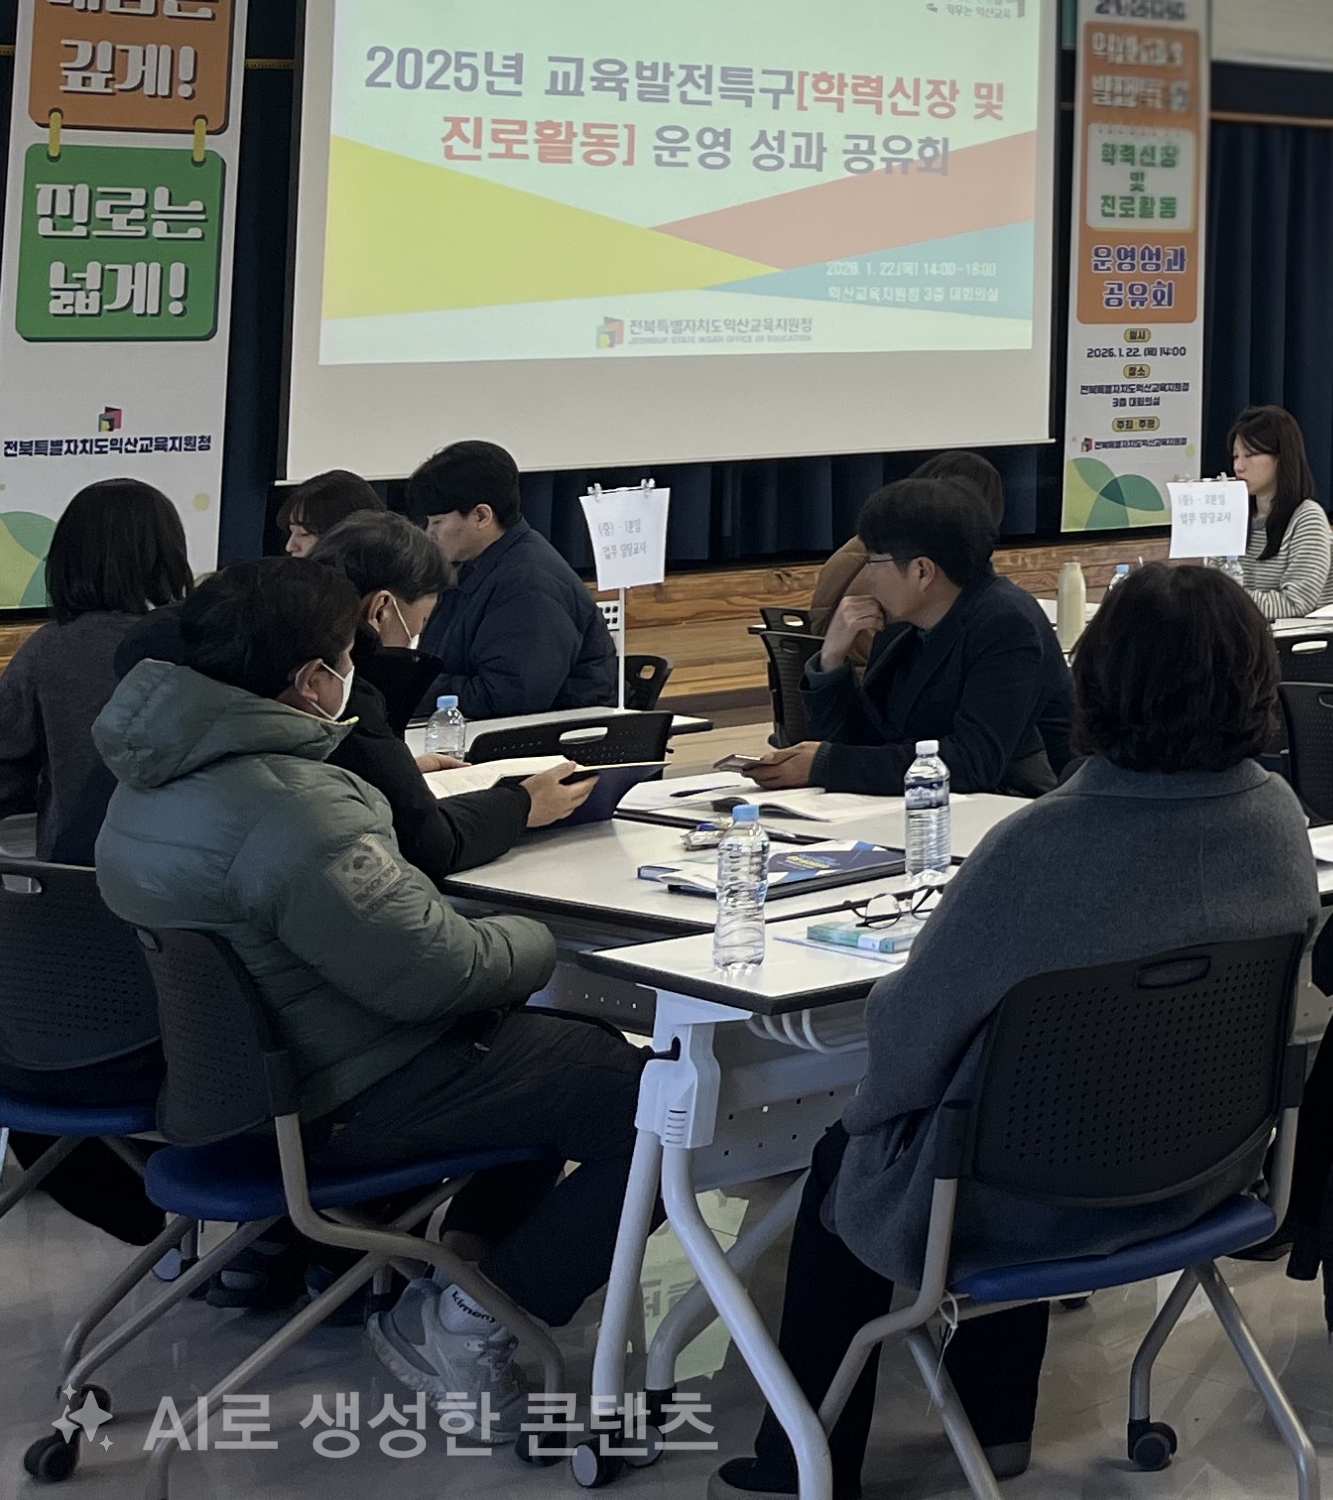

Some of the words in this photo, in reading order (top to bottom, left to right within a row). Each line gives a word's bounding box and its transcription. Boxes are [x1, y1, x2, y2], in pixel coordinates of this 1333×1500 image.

[59, 38, 197, 99] 깊게!
[364, 45, 525, 98] 2025년
[972, 81, 1005, 122] 및
[440, 115, 636, 167] 진로활동]
[653, 124, 732, 171] 운영
[749, 128, 828, 173] 성과
[841, 133, 950, 177] 공유회
[1100, 142, 1179, 168] 학력신장
[1129, 171, 1145, 193] 및
[35, 183, 208, 240] 진로는
[1100, 194, 1177, 220] 진로활동
[1092, 245, 1187, 273] 운영성과
[48, 260, 188, 317] 넓게!
[1103, 280, 1174, 308] 공유회
[628, 317, 814, 336] 전북특별자치도익산교육지원청
[1159, 346, 1187, 357] 14:00
[3, 434, 212, 458] 전북특별자치도익산교육지원청
